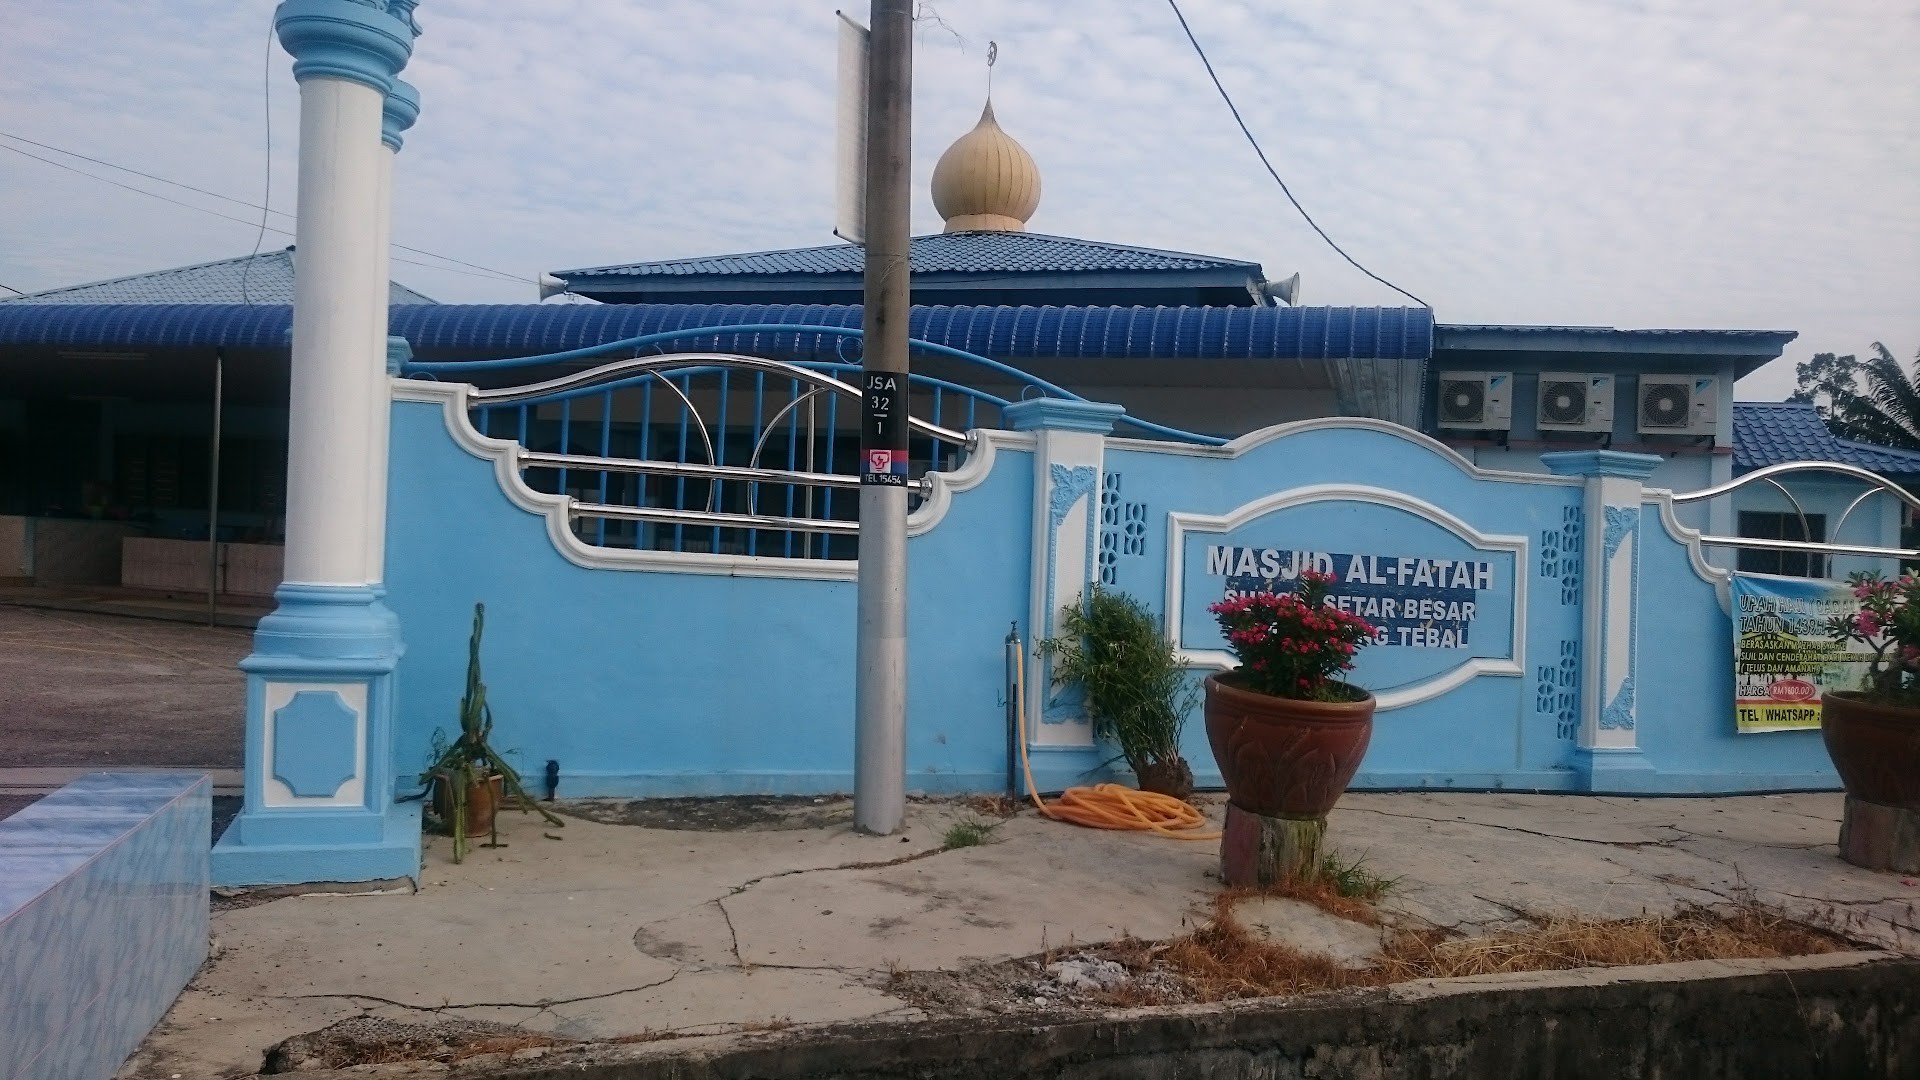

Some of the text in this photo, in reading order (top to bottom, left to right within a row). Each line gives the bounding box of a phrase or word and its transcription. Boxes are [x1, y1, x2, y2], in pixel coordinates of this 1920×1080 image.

[867, 375, 897, 391] JSA
[871, 395, 889, 411] 32
[877, 421, 882, 435] 1
[865, 473, 901, 484] TEL 15454
[1207, 545, 1493, 590] MASJID AL-FATAH
[1322, 594, 1396, 619] SETAR
[1403, 599, 1476, 621] BESAR
[1740, 595, 1776, 613] UPAH
[1740, 615, 1784, 633] TAHUN
[1397, 626, 1469, 648] TEBAL
[1758, 652, 1775, 661] DAN
[1767, 664, 1783, 673] DAN
[1739, 685, 1770, 697] HARGA
[1739, 709, 1759, 722] TEL
[1766, 708, 1815, 722] WHATSAPP
